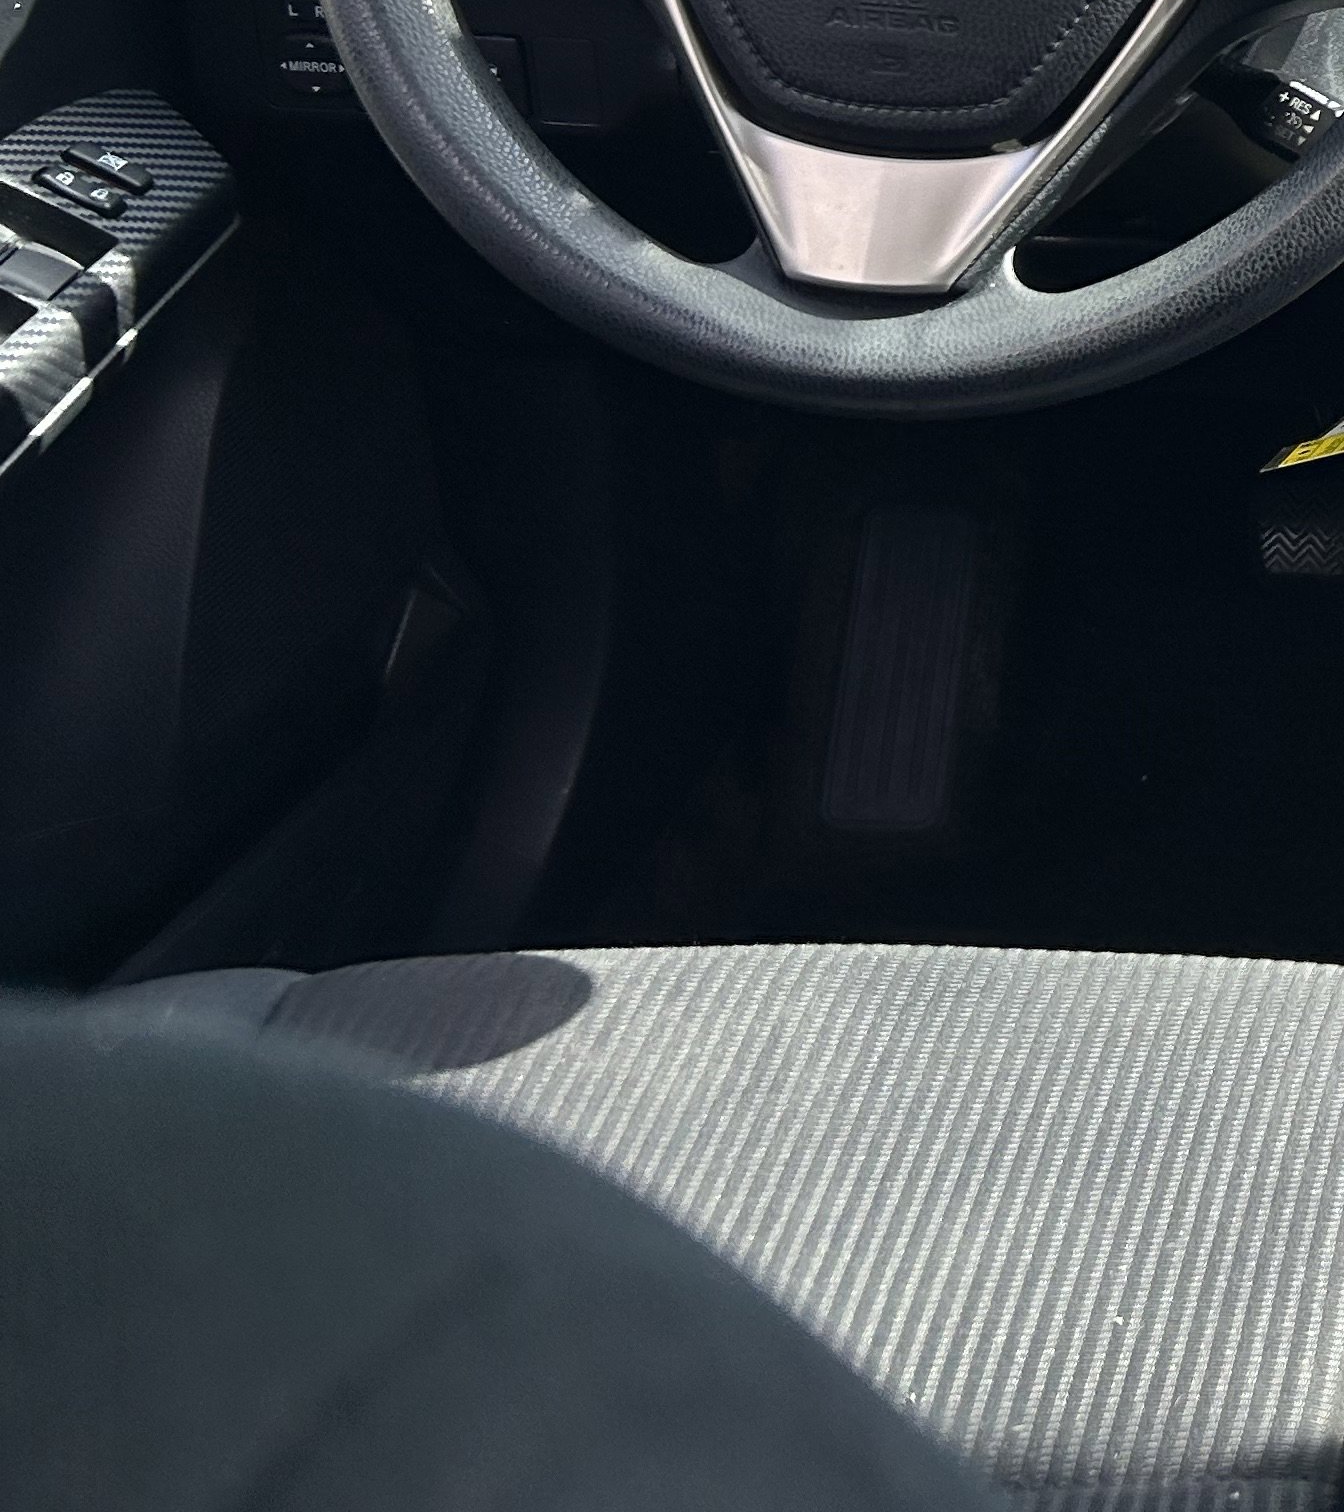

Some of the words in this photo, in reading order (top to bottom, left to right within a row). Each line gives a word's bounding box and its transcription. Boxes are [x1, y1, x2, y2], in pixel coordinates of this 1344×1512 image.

[288, 4, 299, 17] L
[288, 60, 338, 73] MIRROR
[1290, 95, 1313, 116] RES
